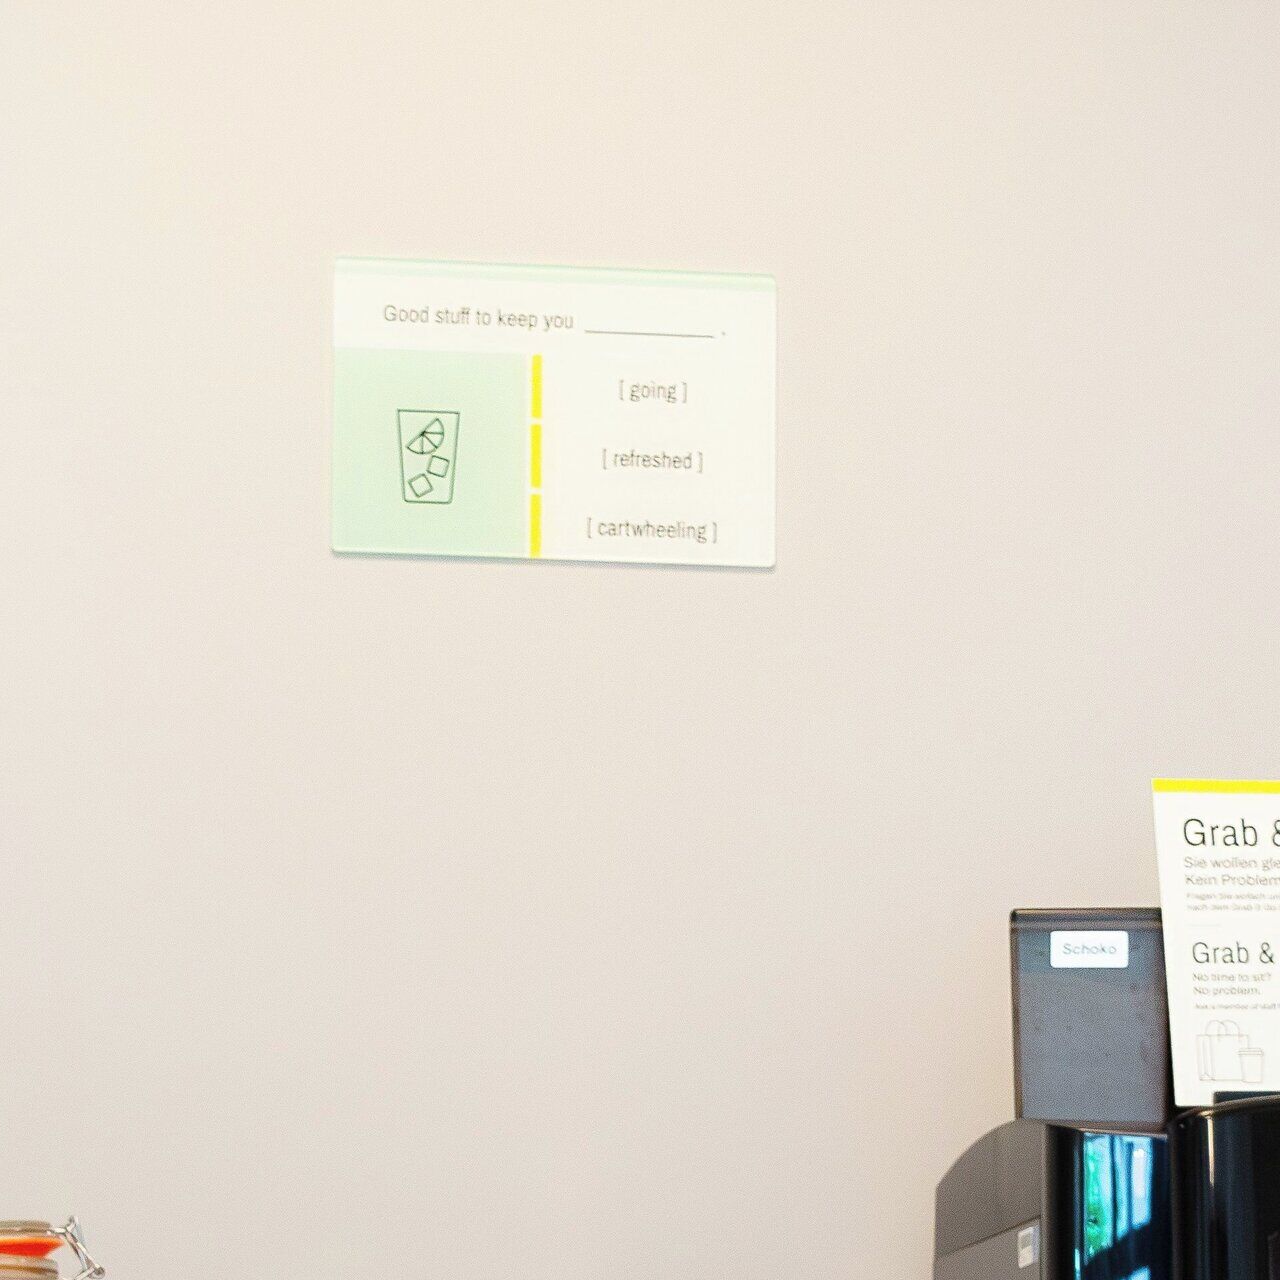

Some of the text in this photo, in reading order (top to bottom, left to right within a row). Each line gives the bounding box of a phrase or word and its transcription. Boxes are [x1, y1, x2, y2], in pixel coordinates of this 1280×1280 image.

[383, 304, 574, 332] Good stuff to keep you
[1183, 818, 1258, 848] Grab
[1184, 856, 1207, 869] Sie
[1210, 856, 1257, 869] wollen
[1185, 874, 1218, 886] Kein
[1062, 943, 1117, 955] Schoko
[1192, 941, 1249, 965] Grab
[1259, 942, 1275, 965] &
[1192, 973, 1208, 982] No
[1193, 986, 1210, 995] No
